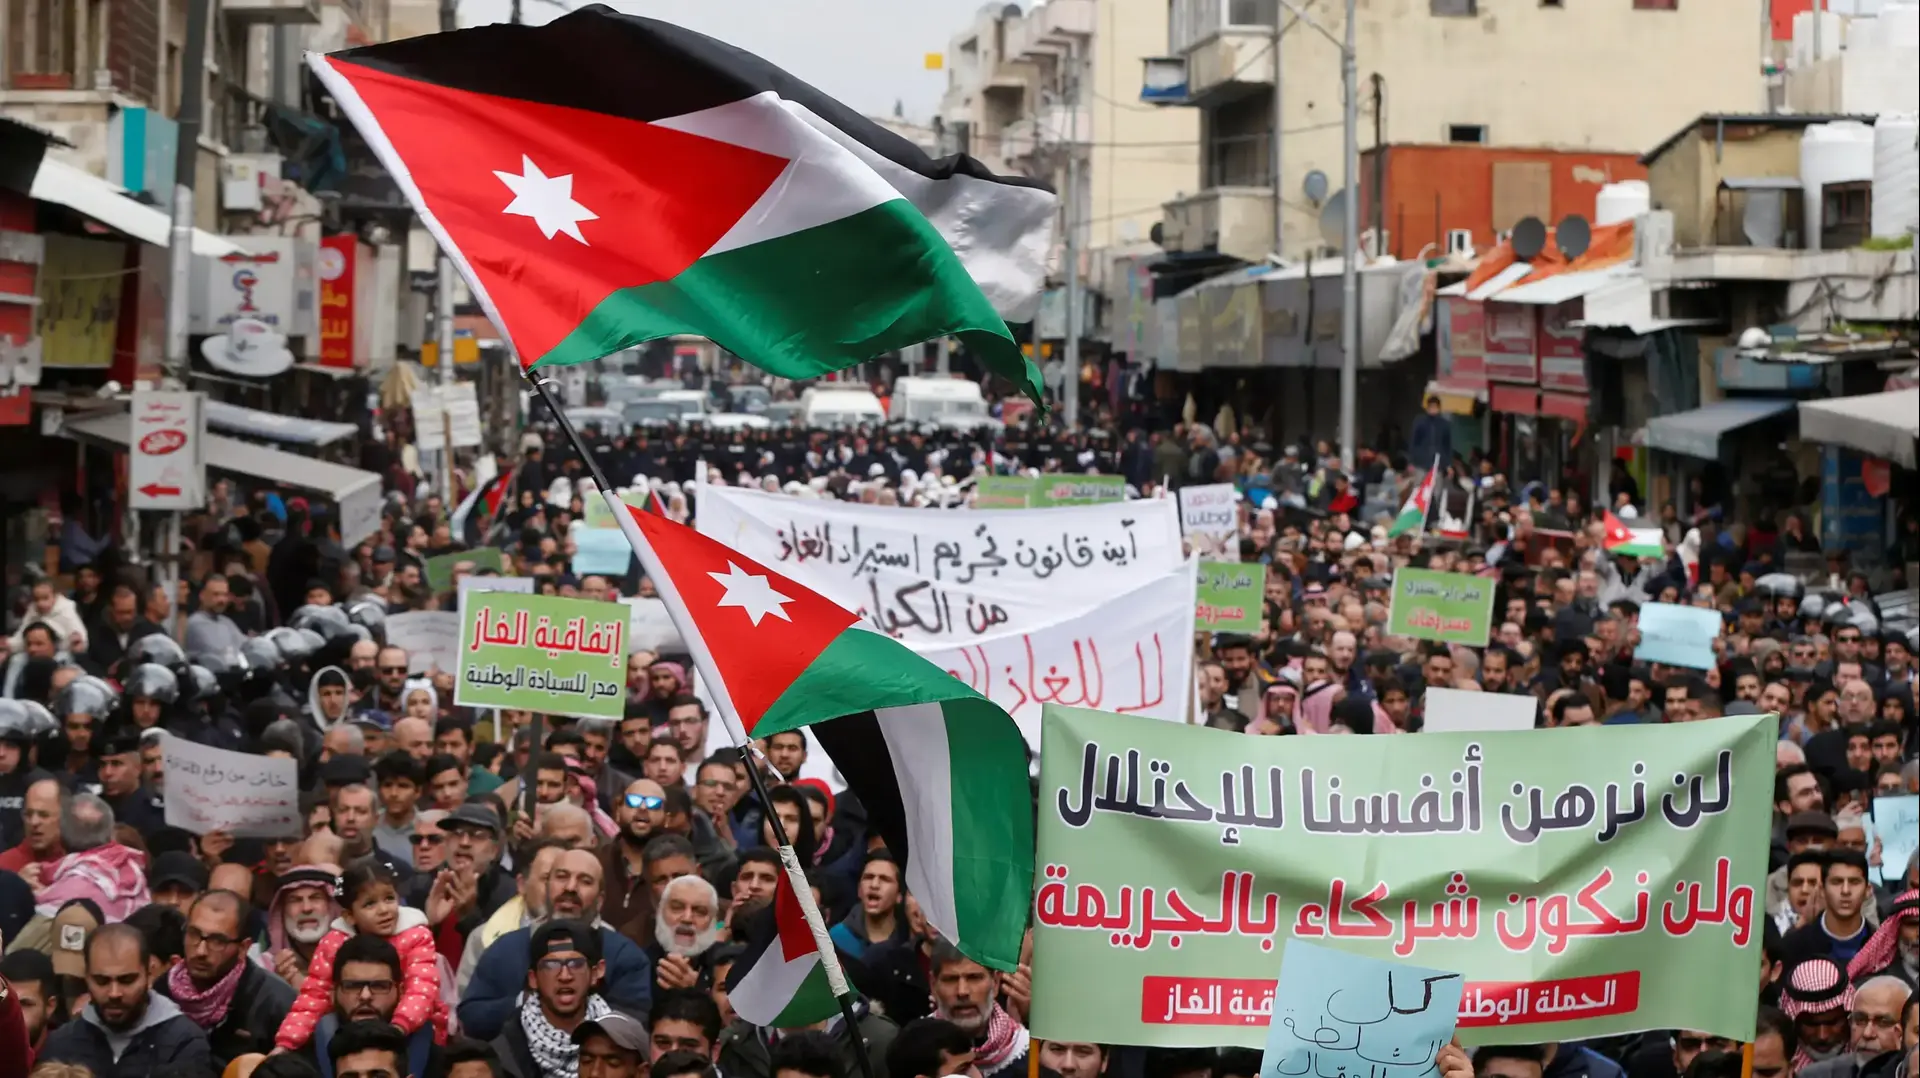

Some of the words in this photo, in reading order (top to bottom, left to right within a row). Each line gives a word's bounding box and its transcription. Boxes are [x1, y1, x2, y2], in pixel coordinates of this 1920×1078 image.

[774, 520, 833, 564] الغاز
[934, 523, 1008, 584] تجريم
[1014, 532, 1095, 579] قانون
[1102, 518, 1136, 566] أين
[470, 607, 529, 652] الغاز
[966, 594, 1009, 635] من
[534, 616, 622, 667] إتفاقية
[466, 663, 525, 691] الوطنية
[528, 668, 587, 697] للسيادة
[589, 678, 619, 700] هدر
[1005, 633, 1104, 717] للغاز
[1115, 631, 1163, 713] لا
[1056, 741, 1284, 845] للإحتلال
[1300, 742, 1482, 834] أنفسنا
[1500, 761, 1647, 844] نرهن
[1662, 749, 1732, 829] لن
[1036, 864, 1280, 952] بالجريمة
[1294, 872, 1479, 957] شركاء
[1495, 867, 1650, 956] نكون
[1662, 857, 1755, 946] ولن
[1163, 983, 1222, 1021] الغاز
[1228, 988, 1275, 1023] قية
[1326, 970, 1461, 1025] كل
[1534, 979, 1618, 1014] الحملة
